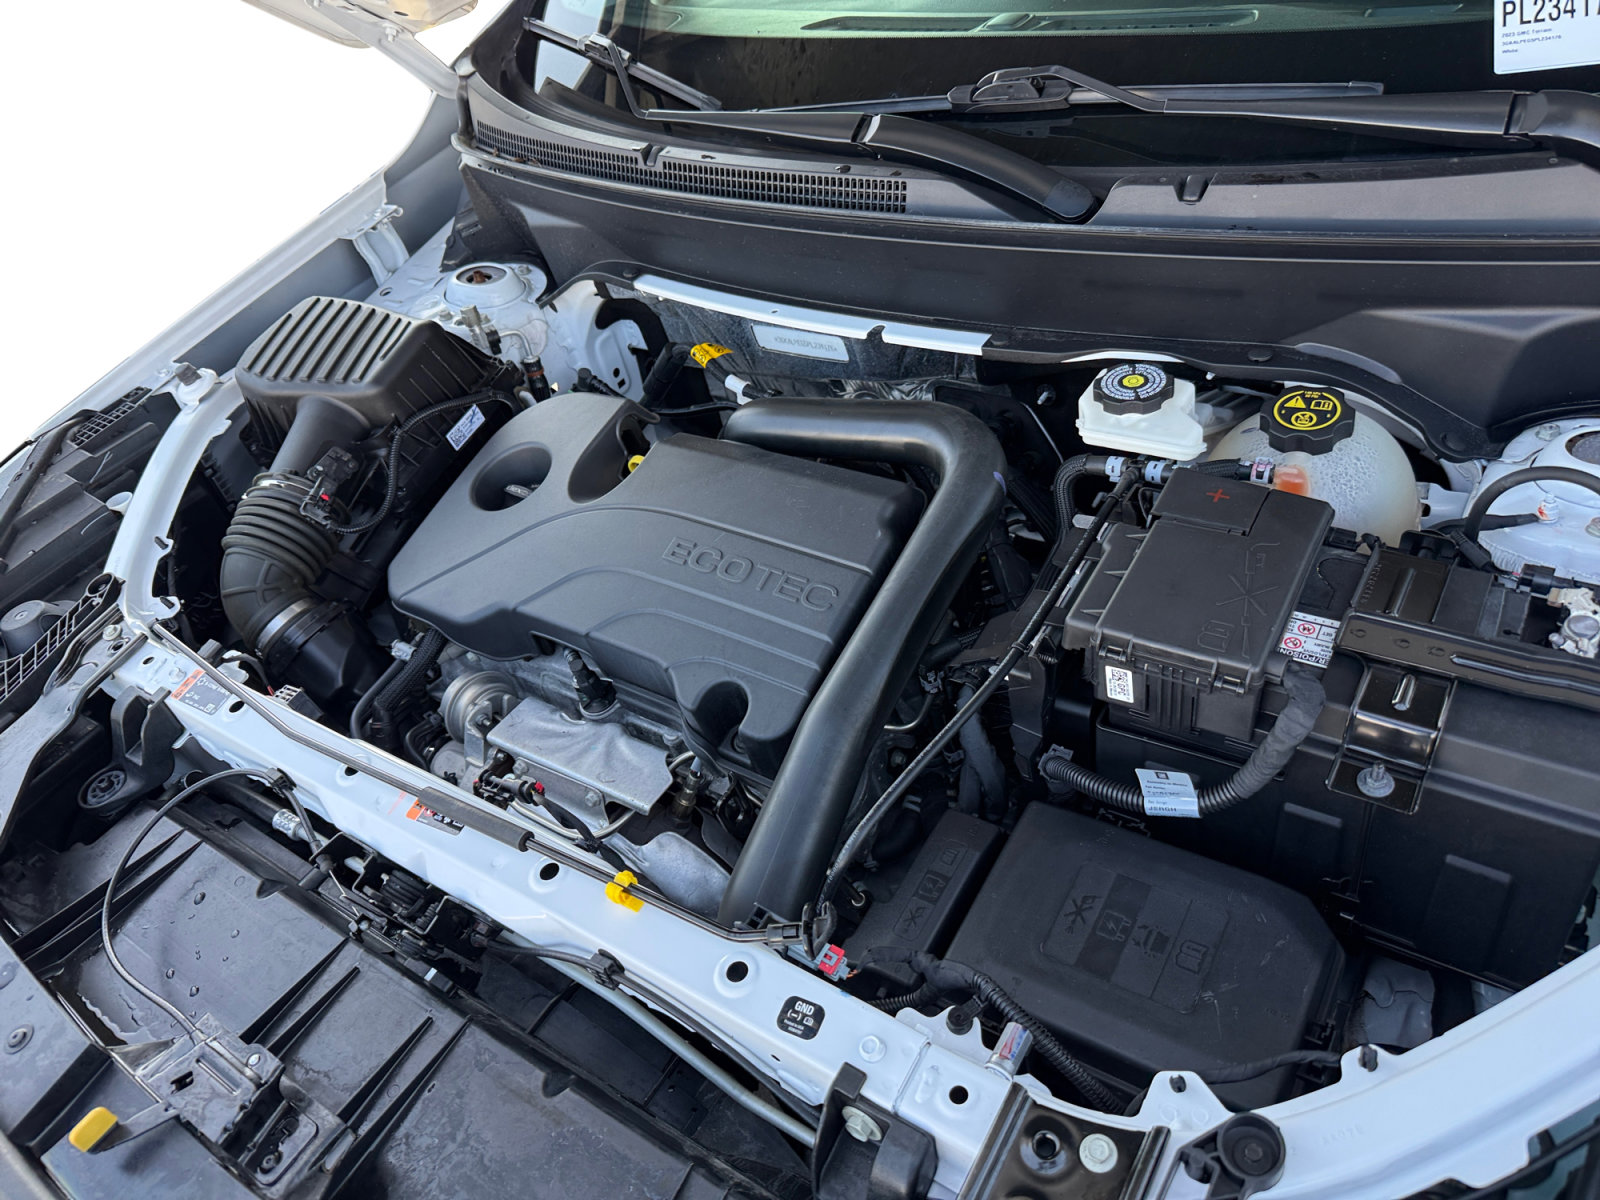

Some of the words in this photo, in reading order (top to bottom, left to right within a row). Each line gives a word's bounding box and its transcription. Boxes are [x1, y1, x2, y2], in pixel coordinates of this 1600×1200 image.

[1502, 0, 1600, 27] PL2341
[662, 536, 839, 612] ECOTEC
[794, 1001, 815, 1016] GND
